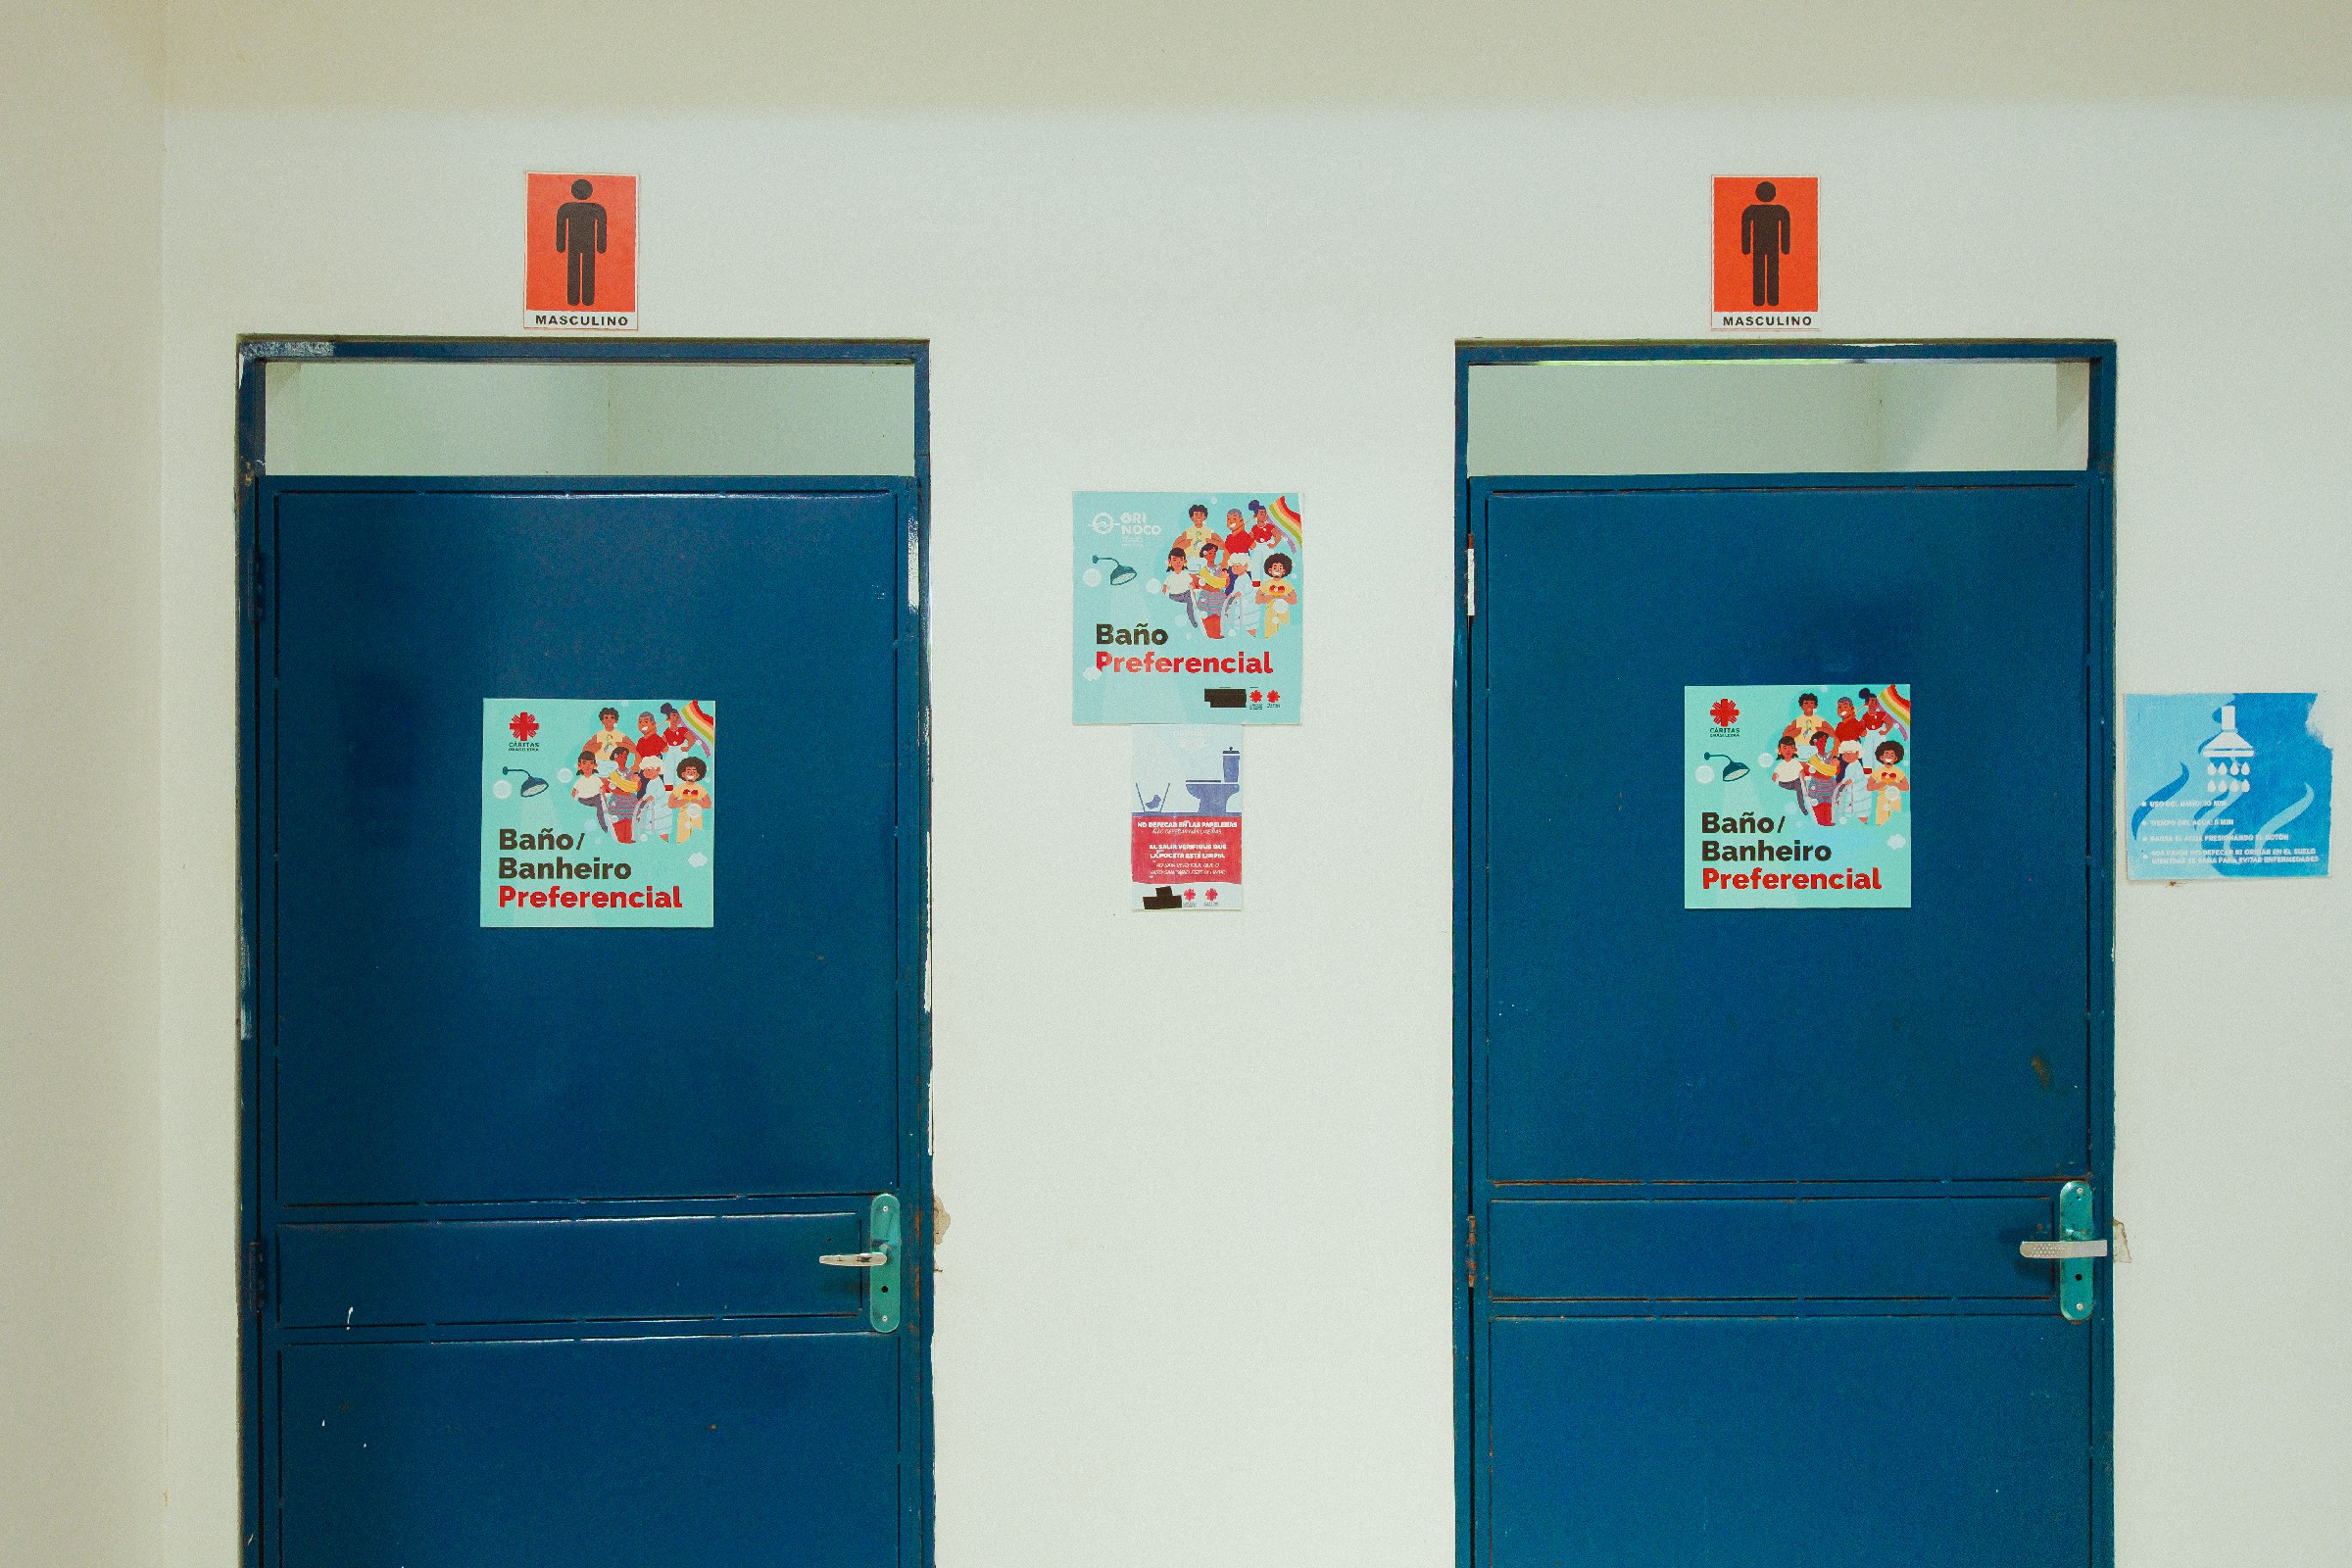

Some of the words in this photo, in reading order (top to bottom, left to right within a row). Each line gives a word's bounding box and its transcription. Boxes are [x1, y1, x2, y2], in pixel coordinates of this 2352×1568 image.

[535, 315, 628, 326] MASCULINO
[1723, 316, 1812, 326] MASCULINO
[1120, 513, 1147, 524] ORI
[1121, 524, 1162, 535] NOCO
[1096, 623, 1168, 646] Baño
[1096, 651, 1274, 674] Preferencial
[1701, 811, 1786, 834] Baño/
[499, 827, 586, 851] Baño/
[1701, 840, 1832, 861] Banheiro
[499, 857, 632, 880] Banheiro
[1702, 866, 1883, 890] Preferencial
[499, 885, 683, 908] Preferencial
